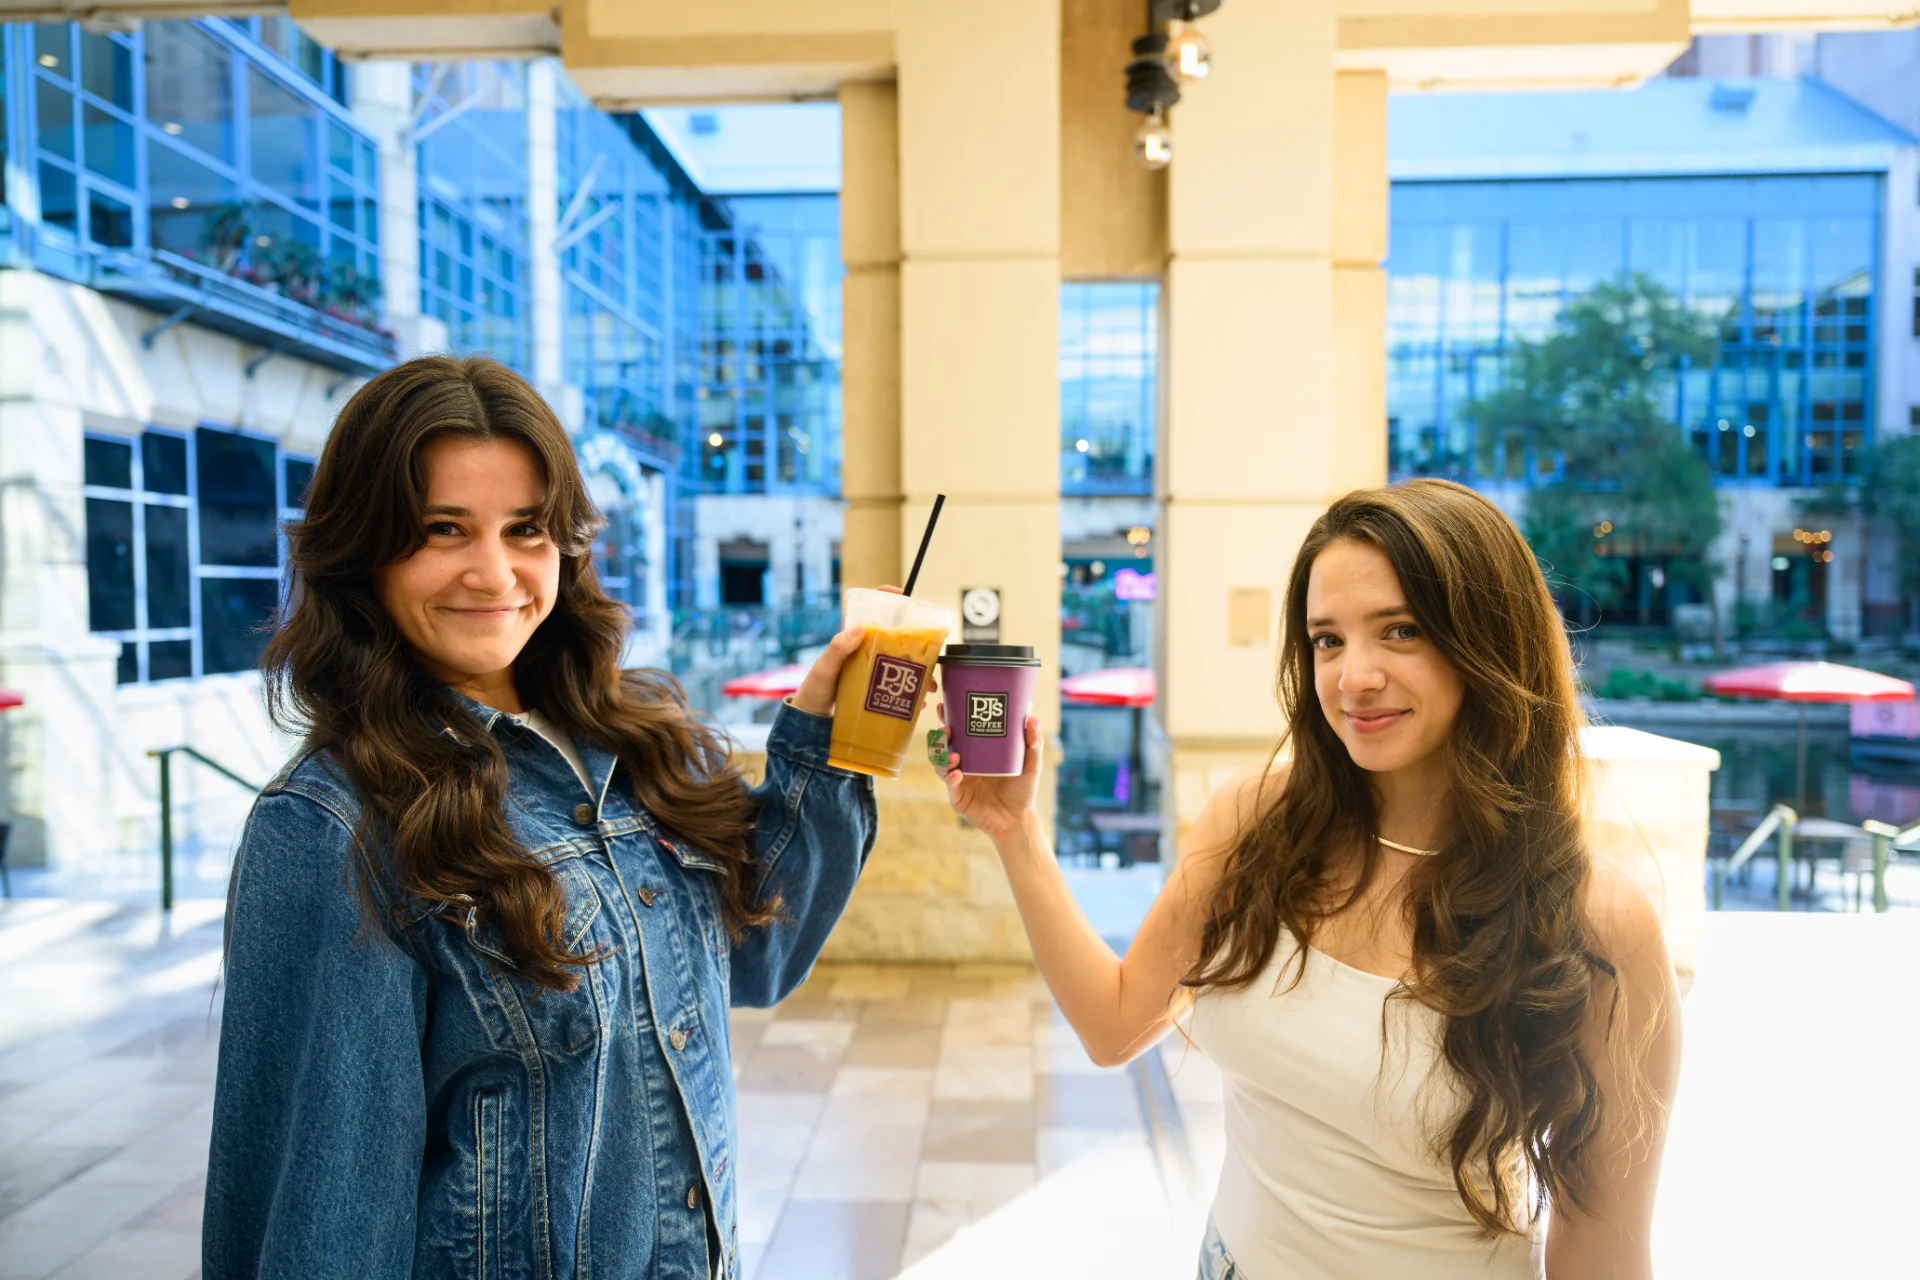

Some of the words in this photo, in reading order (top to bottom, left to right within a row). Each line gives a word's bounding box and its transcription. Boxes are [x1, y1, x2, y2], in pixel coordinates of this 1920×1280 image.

[877, 662, 918, 696] PJ's
[873, 692, 912, 708] COFFEE
[971, 697, 1003, 721] PJ's
